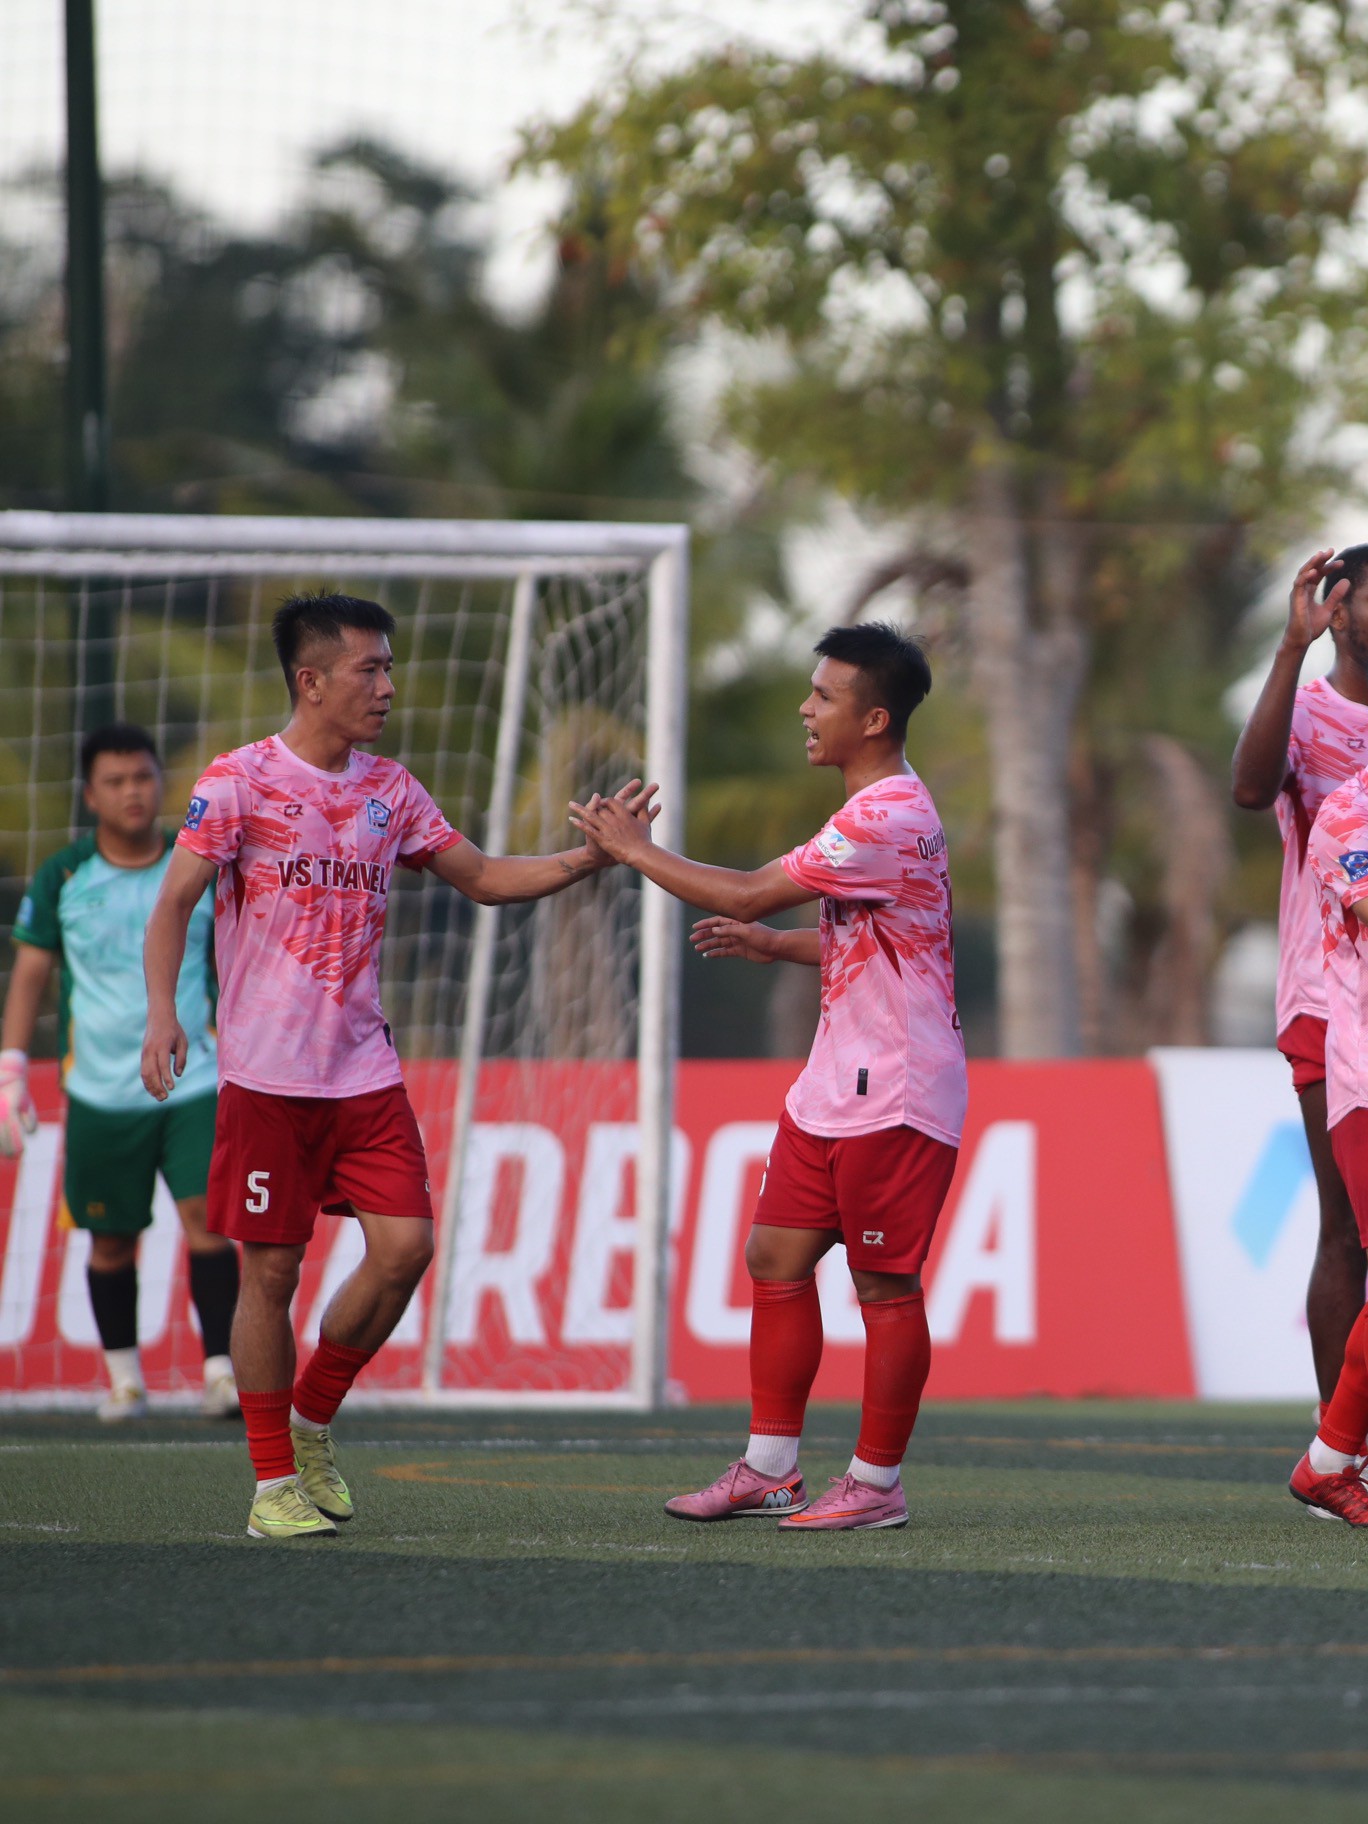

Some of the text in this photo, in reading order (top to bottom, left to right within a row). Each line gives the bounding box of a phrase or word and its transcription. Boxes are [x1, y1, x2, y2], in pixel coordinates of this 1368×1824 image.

[277, 855, 388, 896] VS TRAVEL
[246, 1170, 271, 1214] 5
